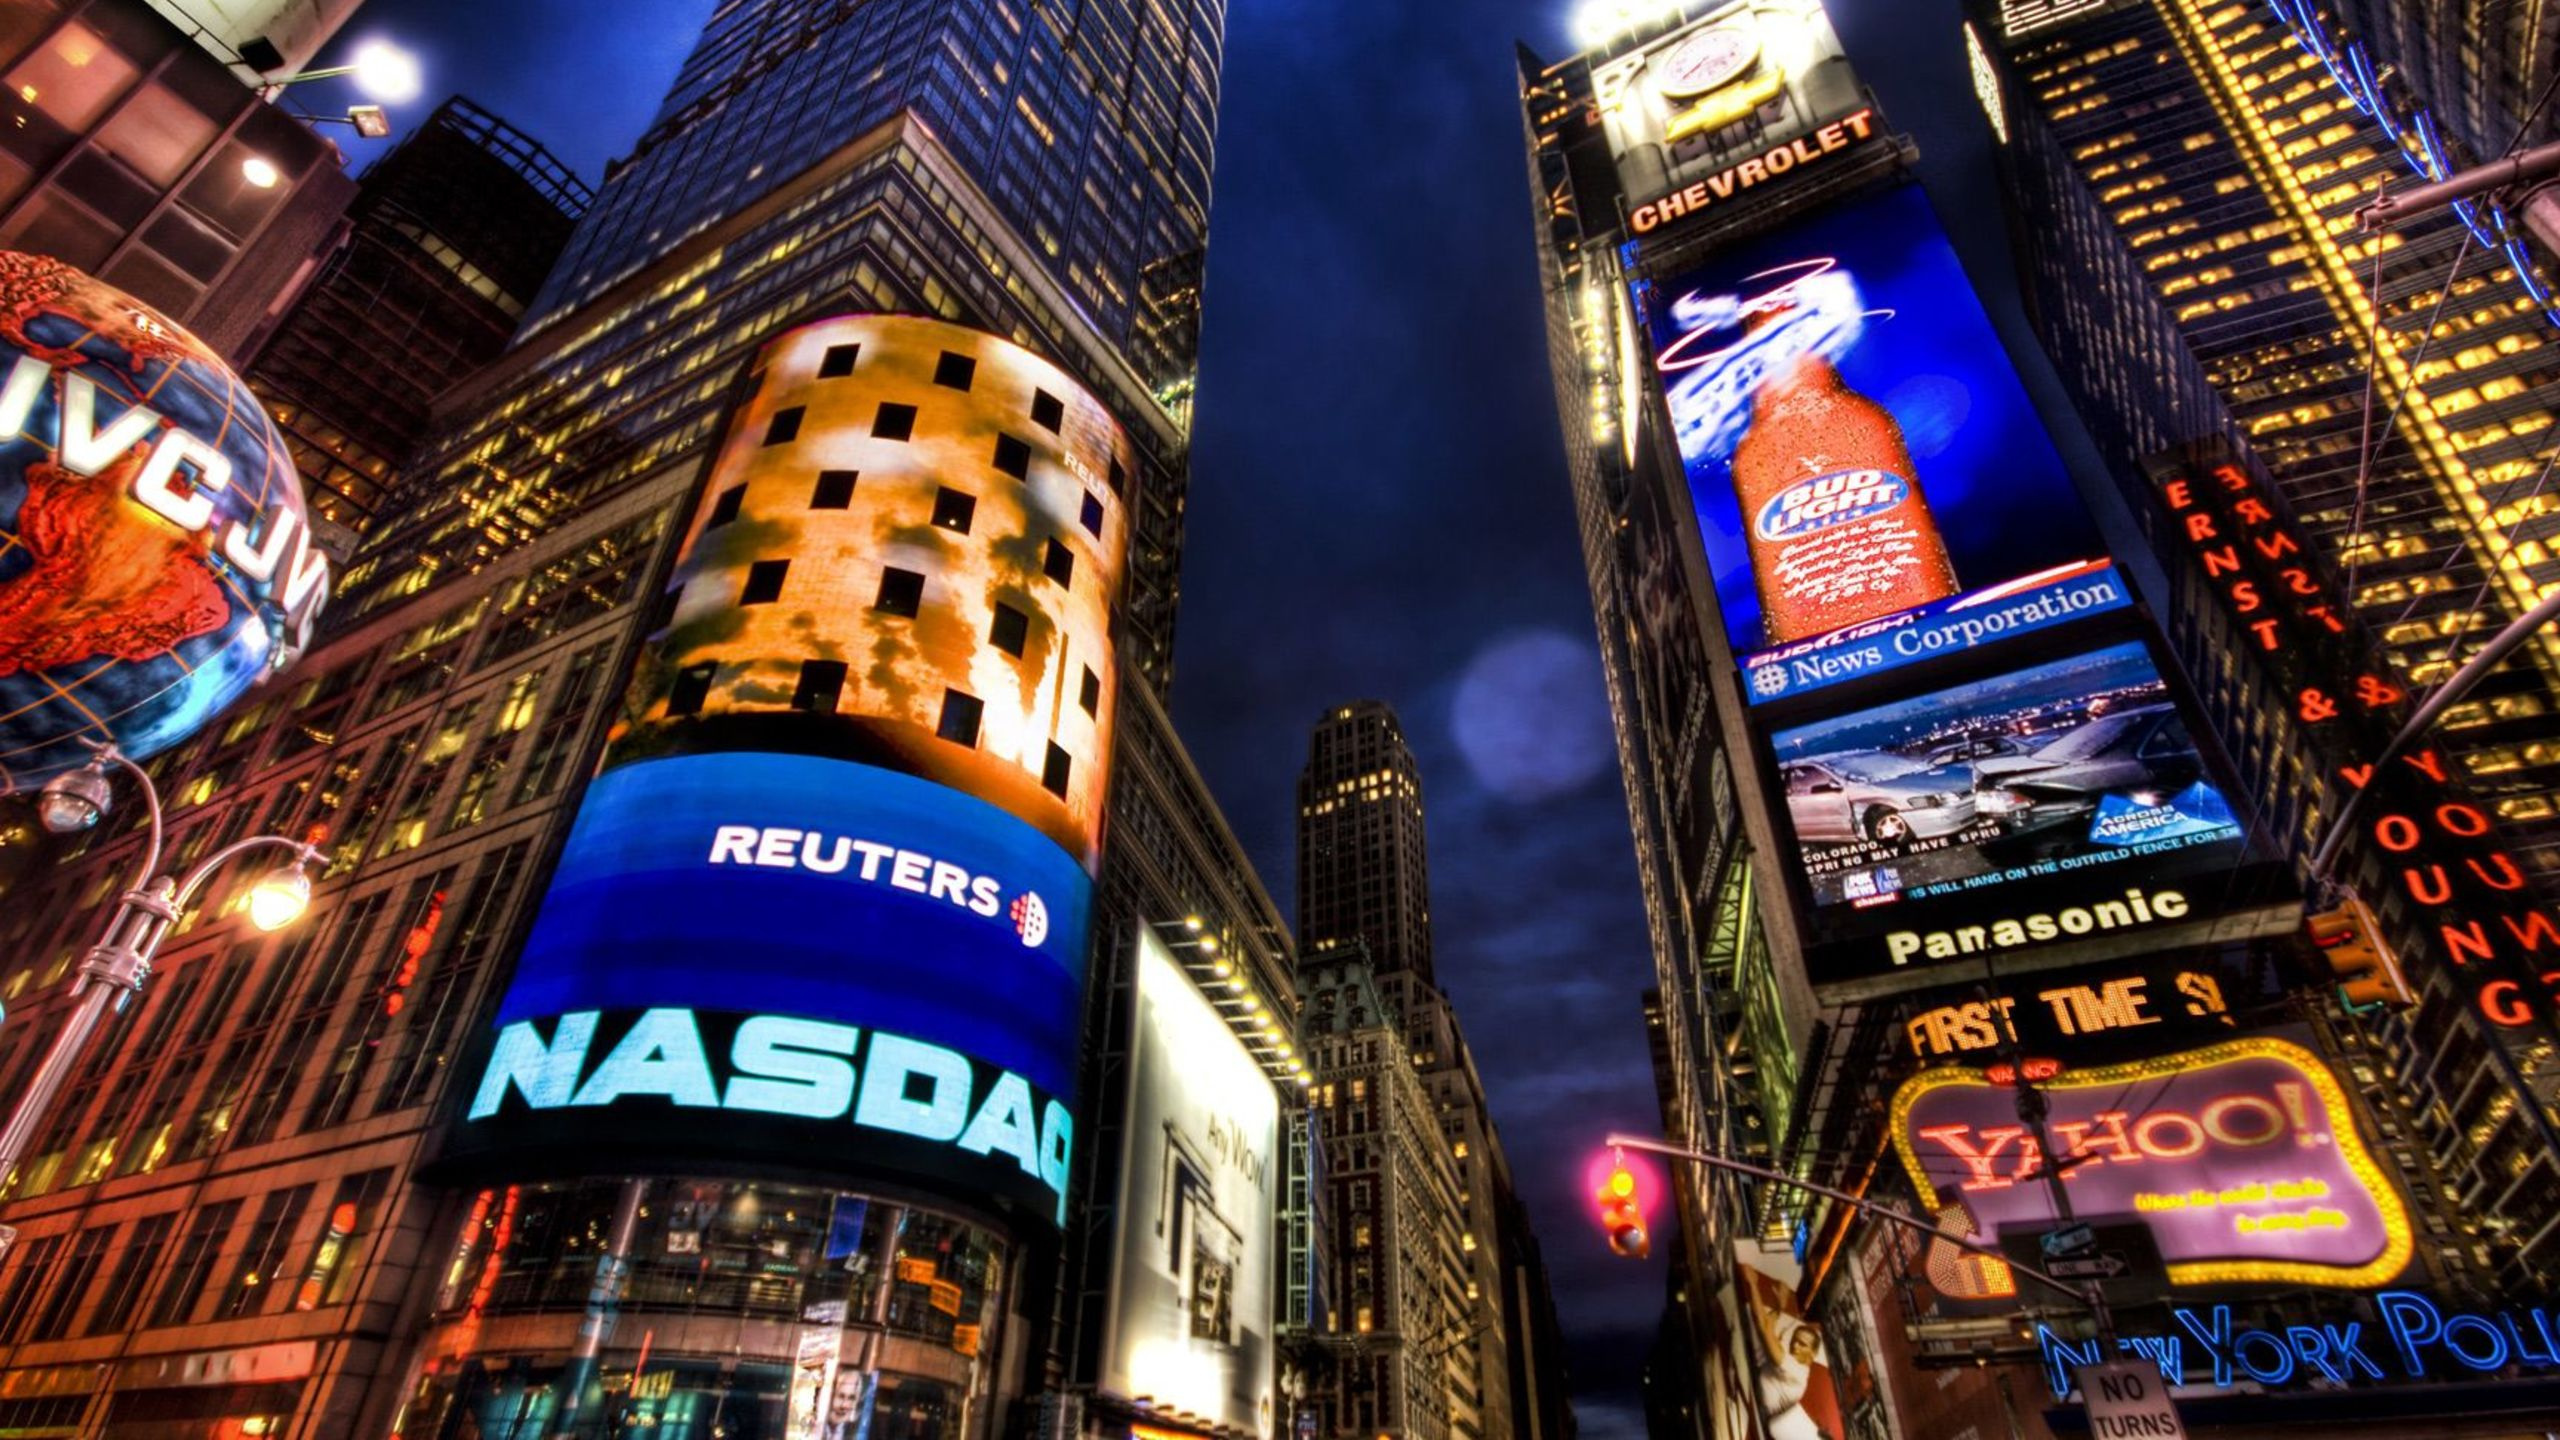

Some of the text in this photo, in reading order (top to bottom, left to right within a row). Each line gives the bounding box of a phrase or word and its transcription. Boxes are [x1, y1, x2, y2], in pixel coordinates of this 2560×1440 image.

[1631, 108, 1873, 234] CHEVROLET
[1769, 484, 1899, 535] LIGHT
[1781, 469, 1883, 512] BUD
[1792, 583, 2118, 686] News Corporation
[2165, 480, 2280, 653] ERNST
[2300, 687, 2339, 722] &
[1872, 847, 1899, 862] MAY
[1909, 837, 1950, 854] HAVE
[2093, 810, 2190, 838] AMERICA
[2101, 804, 2175, 826] ACROSS
[709, 825, 1001, 918] REUTERS
[1928, 882, 1962, 897] WILL
[1964, 874, 2003, 890] HANG
[2006, 867, 2028, 881] ON
[2029, 860, 2060, 876] THE
[2060, 847, 2130, 870] OUTFIELD
[2132, 837, 2183, 857] FENCE
[2184, 831, 2216, 846] FOR
[1886, 888, 2190, 966] Panasonic
[1906, 996, 2020, 1058] FIRST
[2038, 975, 2163, 1036] TIME
[467, 1007, 1073, 1229] NASDAQ
[1919, 1083, 2313, 1192] YAHOO!
[2173, 1304, 2385, 1388] YORK
[2376, 1291, 2560, 1377] POLI
[2094, 1412, 2177, 1440] TURNS
[2098, 1373, 2145, 1403] NO
